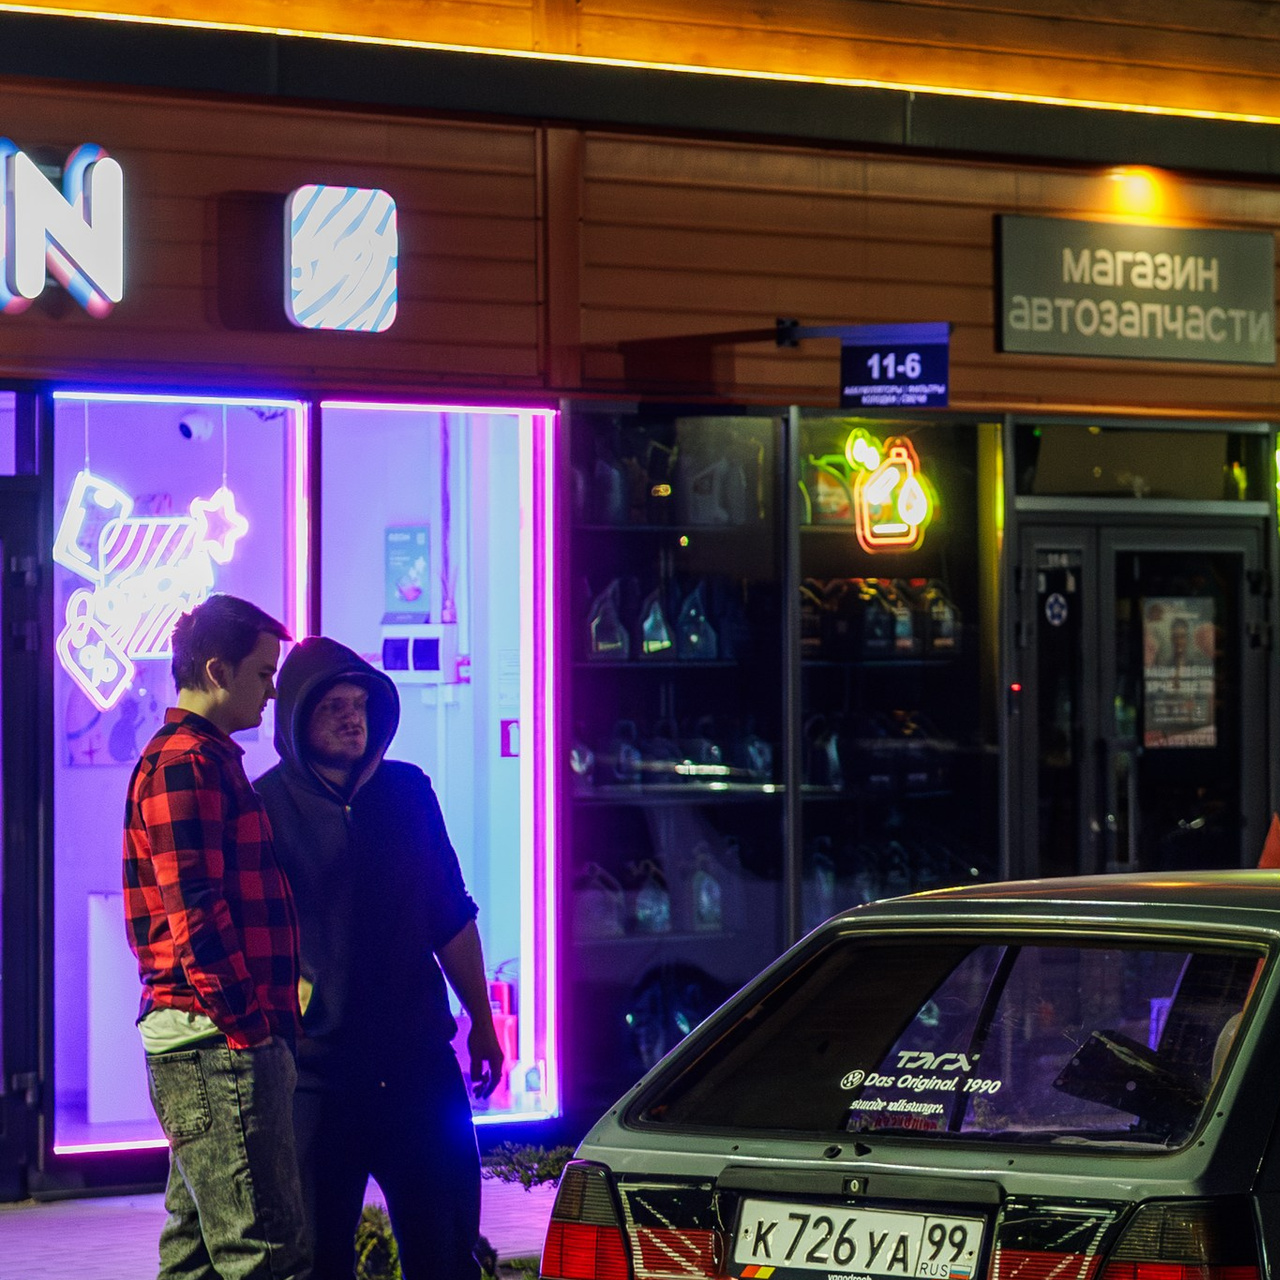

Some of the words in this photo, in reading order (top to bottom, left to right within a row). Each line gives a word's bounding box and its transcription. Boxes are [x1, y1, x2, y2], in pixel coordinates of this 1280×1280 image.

[1062, 247, 1219, 293] магазин
[1009, 295, 1271, 344] автозапчасти
[867, 353, 922, 380] 11-6
[864, 1073, 896, 1088] Das
[897, 1074, 959, 1093] Original.
[963, 1078, 1002, 1095] 1990
[926, 1223, 968, 1263] 99
[920, 1262, 949, 1278] RUS
